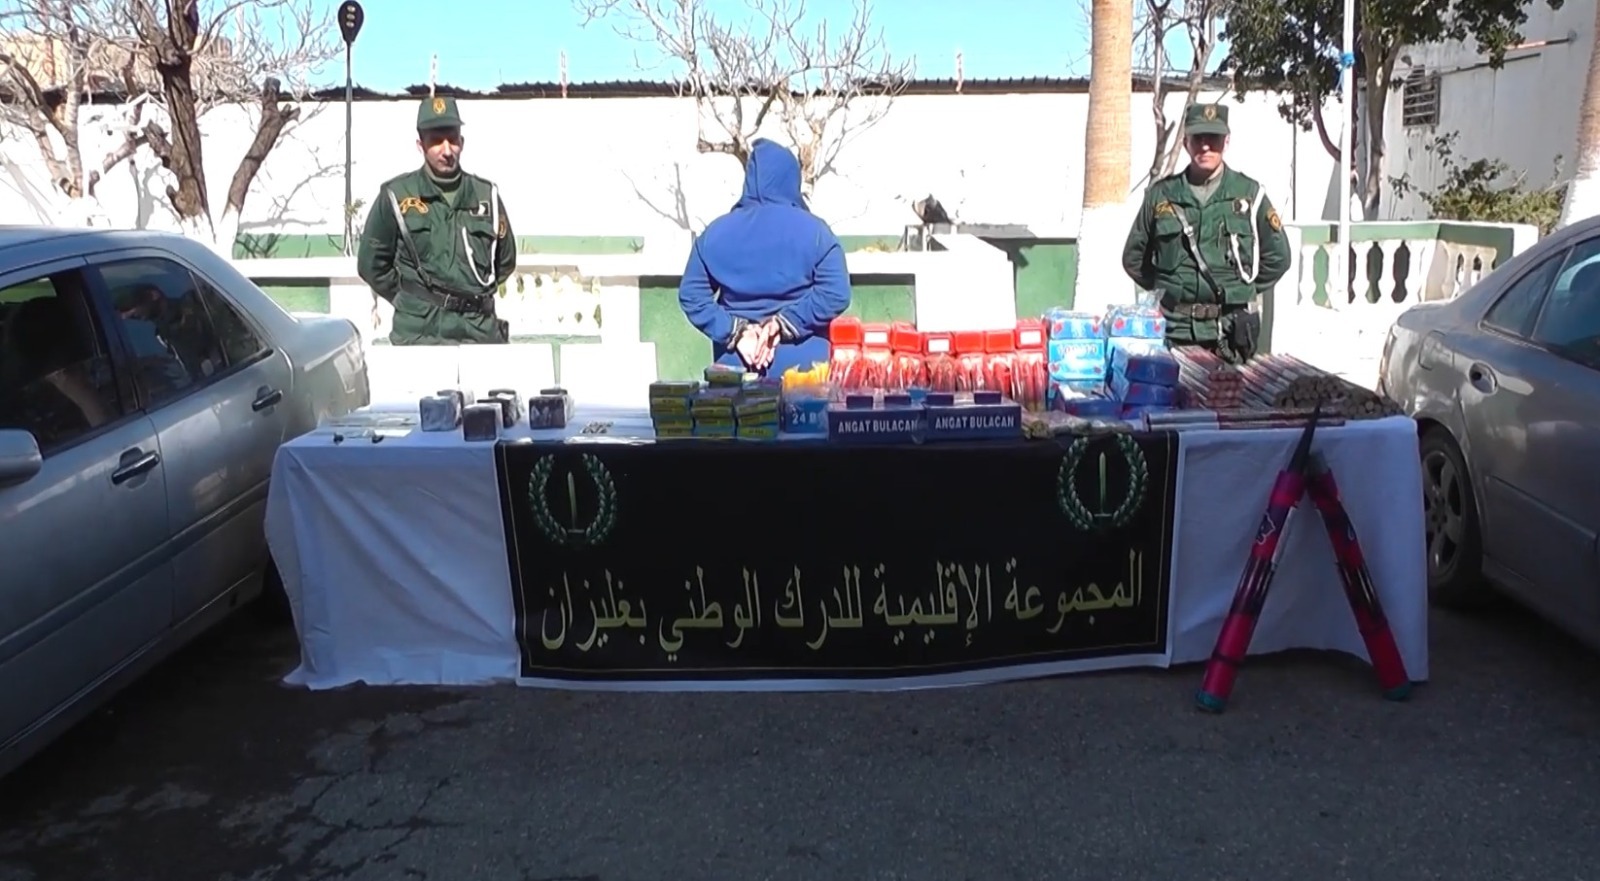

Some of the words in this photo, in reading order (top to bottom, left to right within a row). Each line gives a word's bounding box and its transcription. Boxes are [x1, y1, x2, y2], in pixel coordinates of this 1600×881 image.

[838, 420, 870, 434] ANGAT
[873, 419, 918, 433] BULACAN
[935, 416, 967, 430] ANGAT
[969, 415, 1014, 430] BULACAN
[541, 569, 648, 652] بغليزان
[658, 565, 761, 662] الوطني
[775, 565, 863, 650] للدرك
[873, 560, 992, 647] الإقليمية
[1004, 548, 1142, 633] المجموعة
